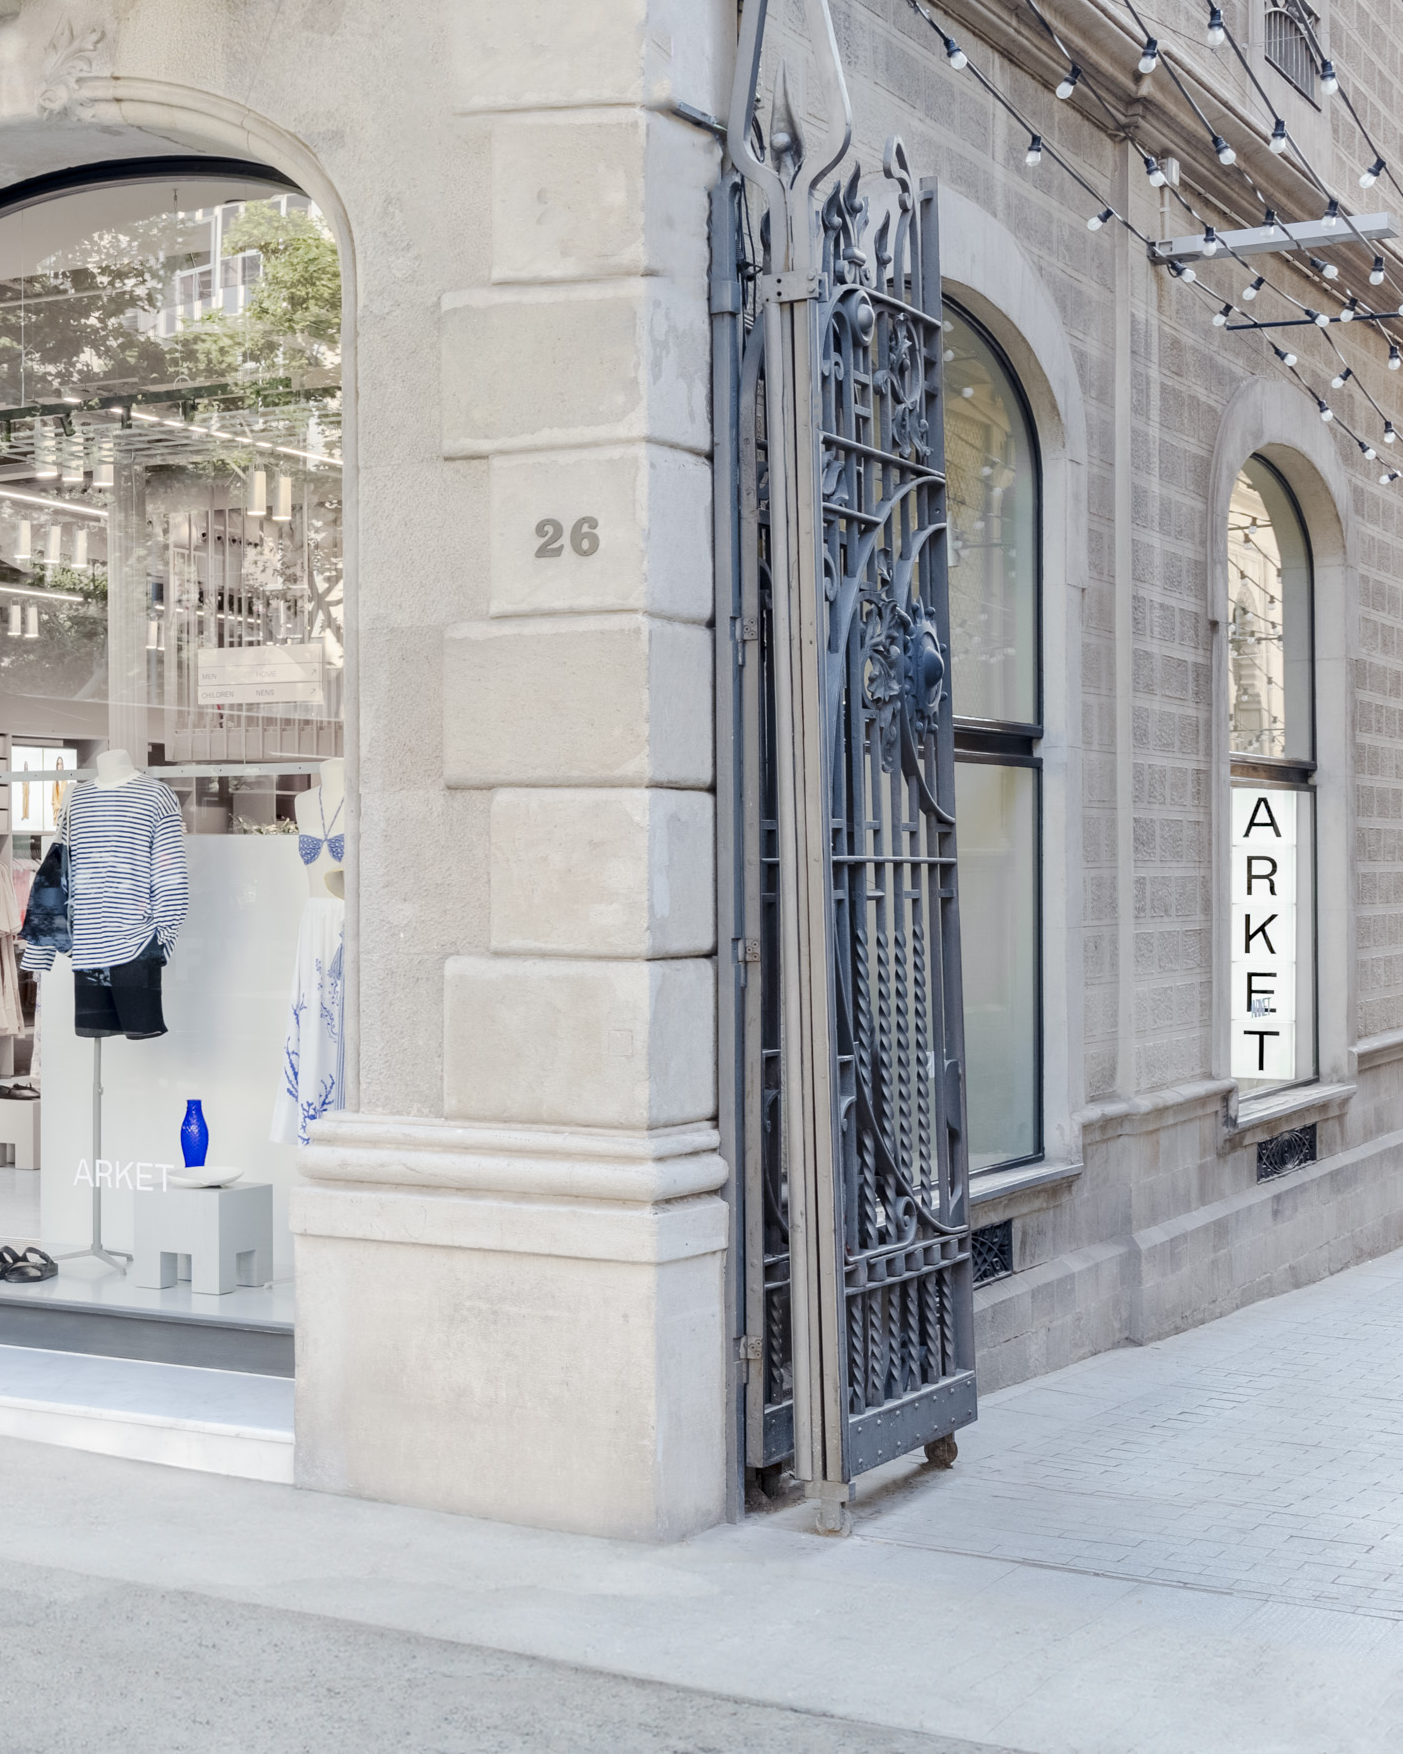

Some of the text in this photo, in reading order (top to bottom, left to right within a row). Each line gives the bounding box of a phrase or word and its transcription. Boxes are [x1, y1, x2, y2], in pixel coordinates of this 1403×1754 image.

[534, 515, 601, 558] 26
[201, 670, 278, 680] MEN HOME
[200, 688, 276, 700] CHILDREN NENS
[1242, 797, 1282, 1071] ARKET
[73, 1158, 175, 1193] ARKET
